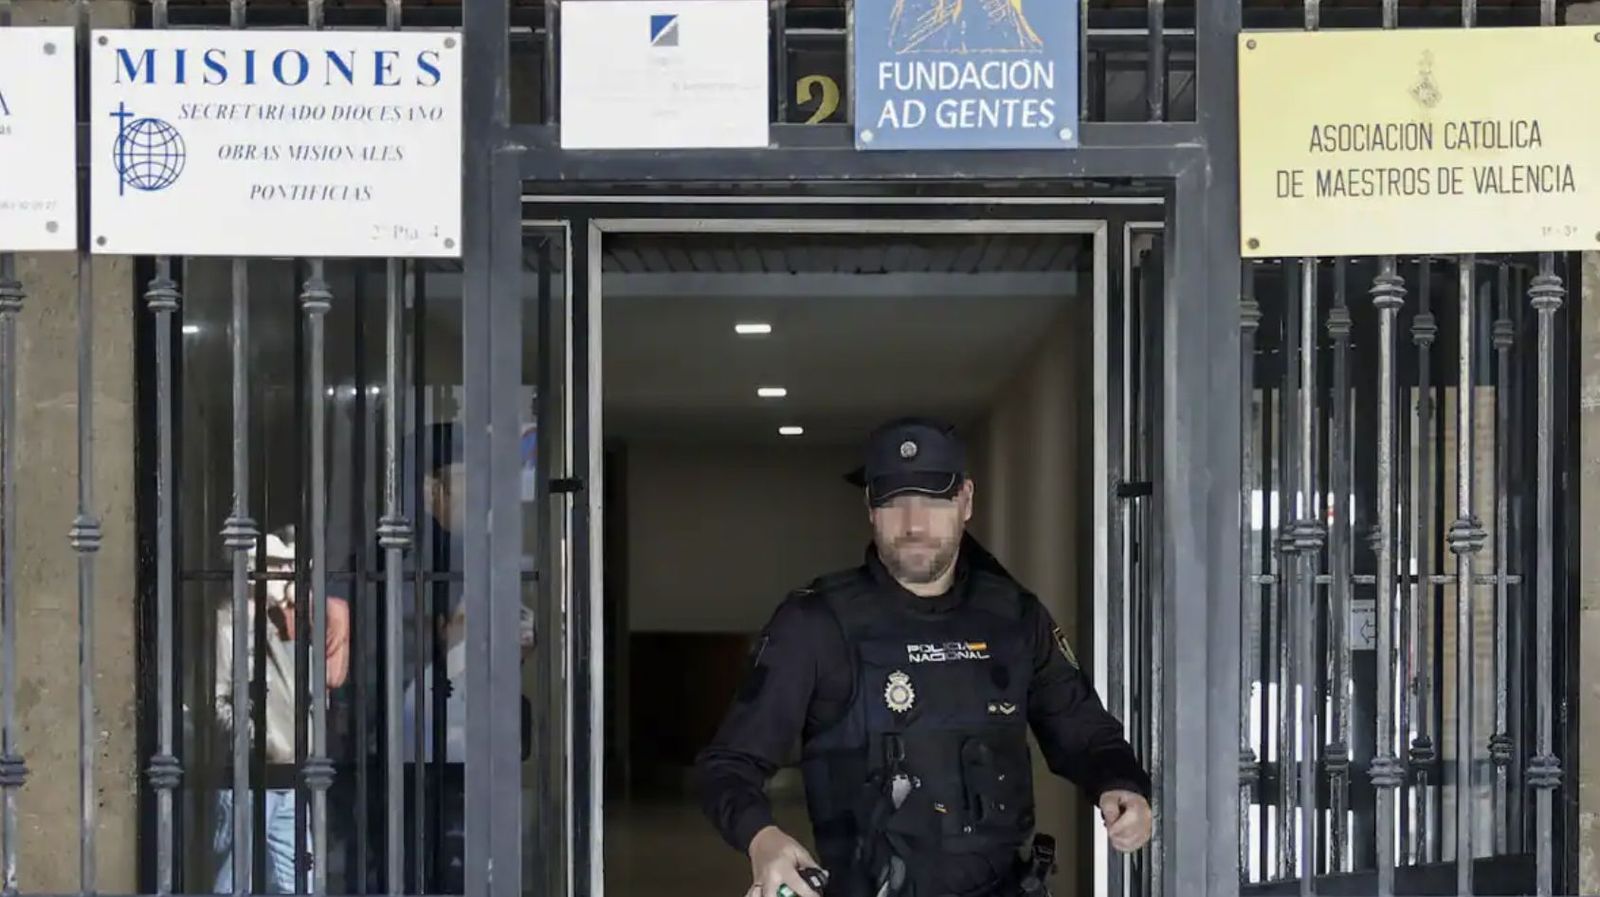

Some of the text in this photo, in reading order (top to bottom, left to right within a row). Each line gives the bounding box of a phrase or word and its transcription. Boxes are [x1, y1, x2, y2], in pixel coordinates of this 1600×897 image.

[114, 48, 442, 87] MISIONES
[178, 103, 444, 122] SECRETARIADO DIOCESANO
[796, 75, 840, 125] 2
[877, 97, 1056, 129] AD GENTES
[217, 144, 404, 161] OBRAS MISIONALES
[249, 184, 372, 201] PONTIFICIAS
[1276, 164, 1576, 198] DE MAESTROS DE VALENCIA
